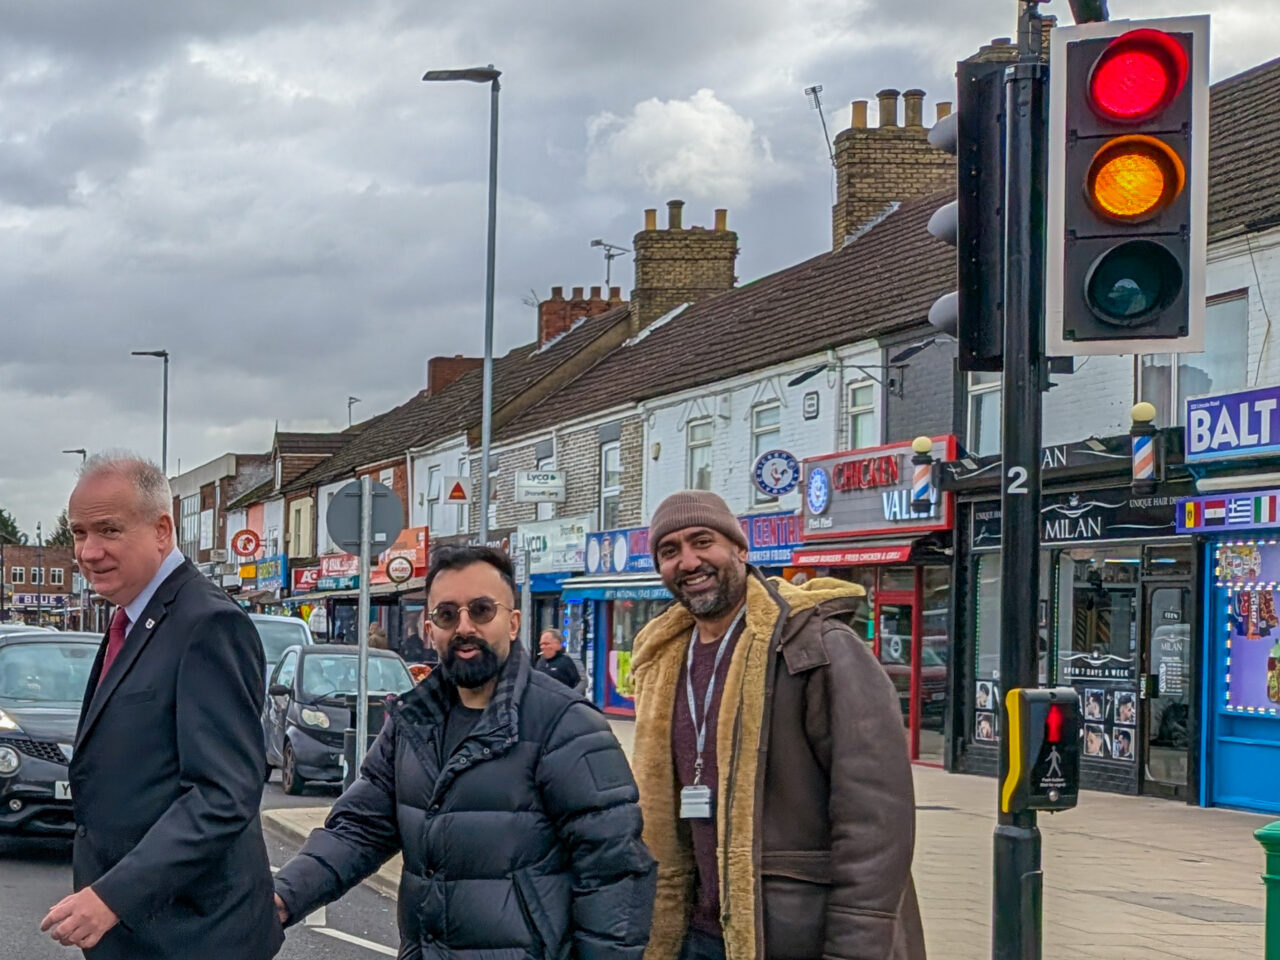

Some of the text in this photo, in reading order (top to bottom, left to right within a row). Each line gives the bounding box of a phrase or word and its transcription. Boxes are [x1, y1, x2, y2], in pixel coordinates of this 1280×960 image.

[832, 455, 898, 491] CHICKEN
[1007, 467, 1028, 494] 2
[1130, 499, 1152, 508] UNIQUE
[1045, 517, 1102, 540] MILAN
[1161, 642, 1182, 651] MILAN
[1087, 668, 1102, 677] DAYS
[1112, 669, 1129, 677] WEEK
